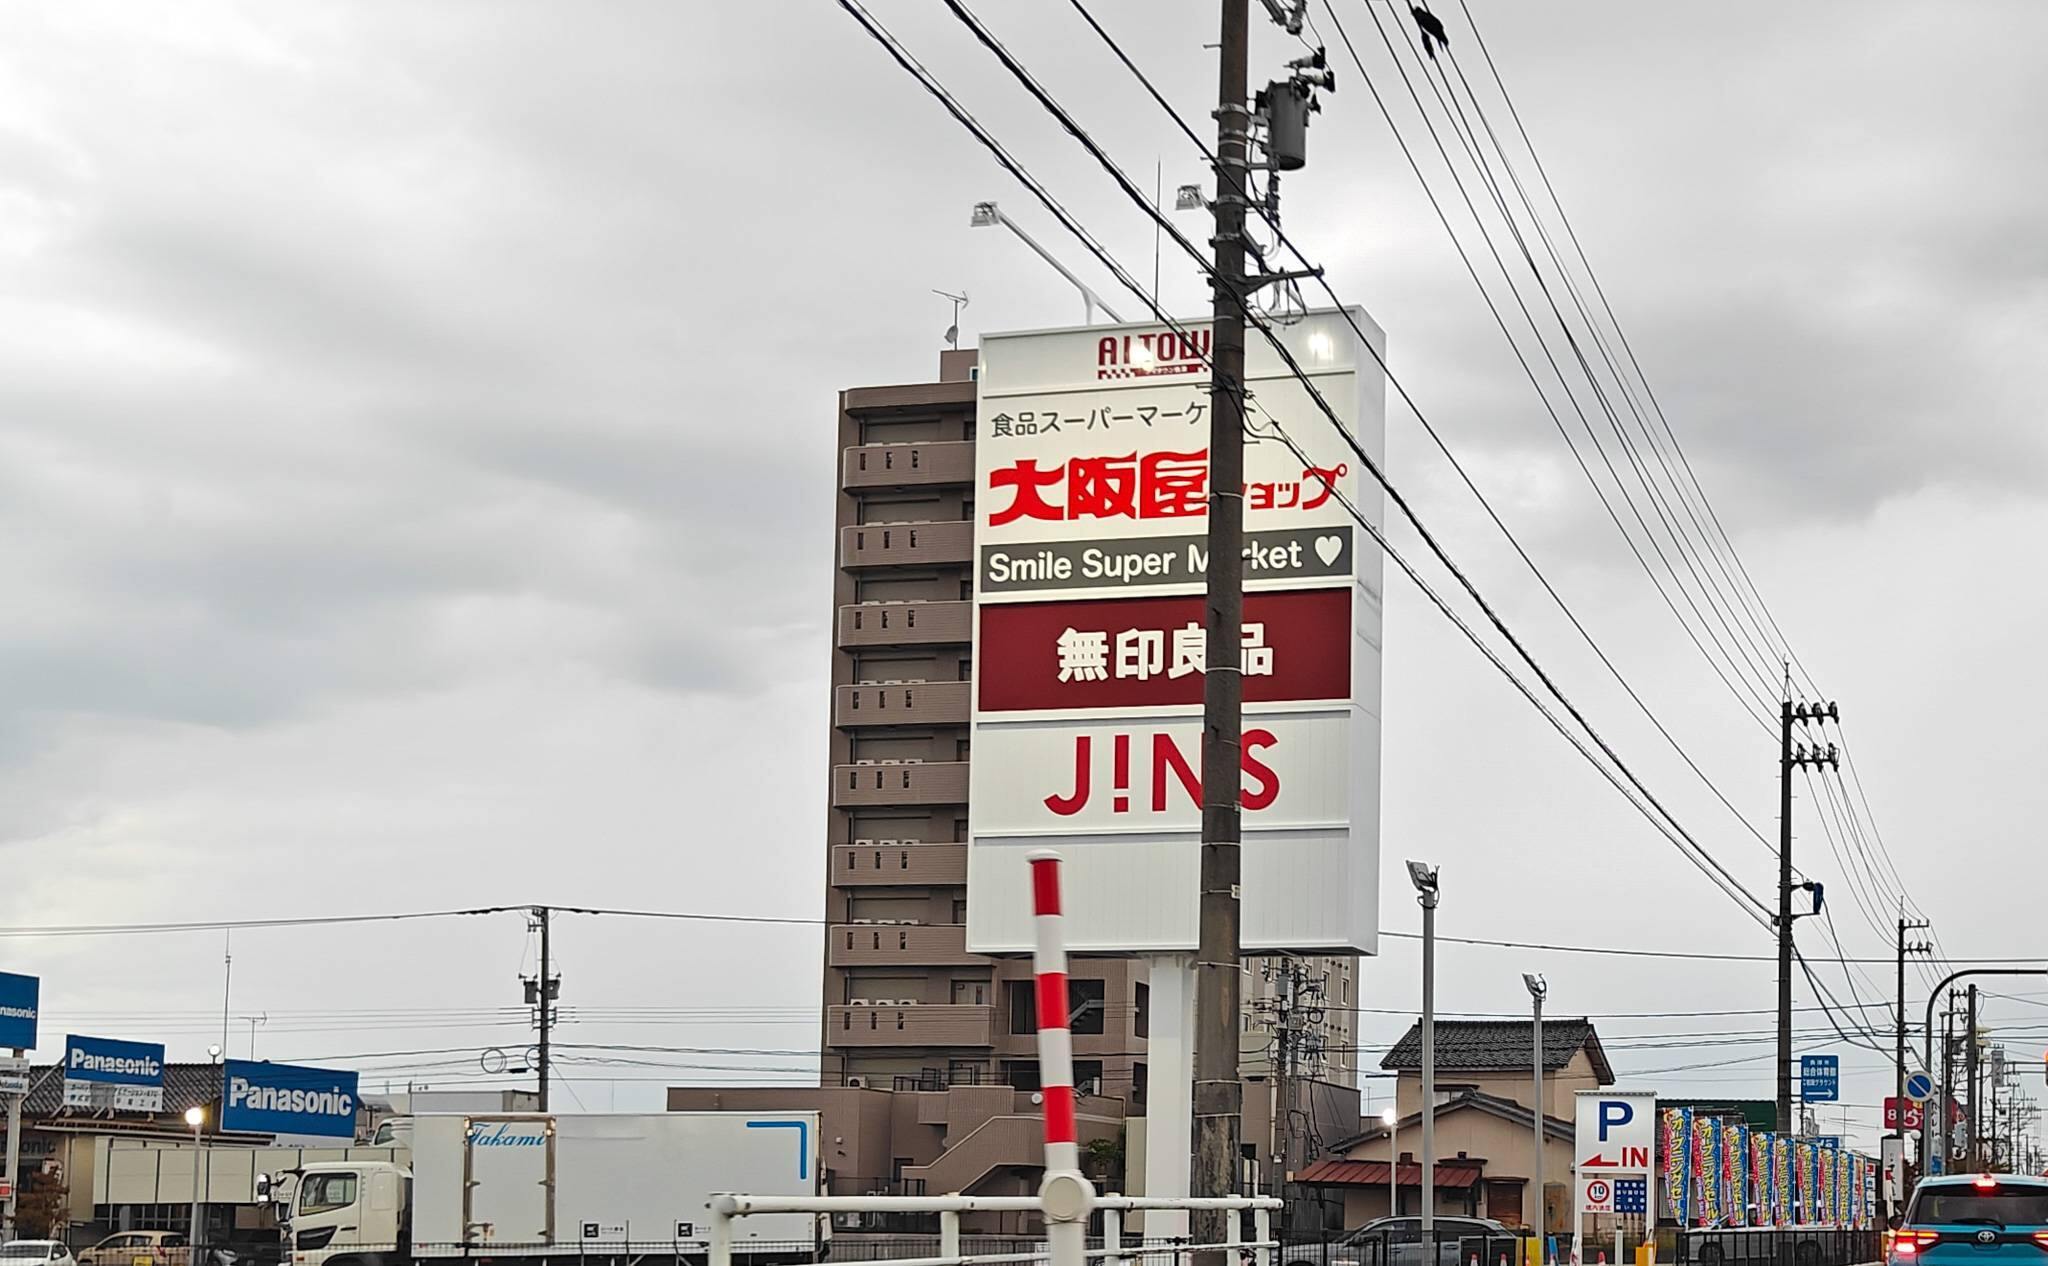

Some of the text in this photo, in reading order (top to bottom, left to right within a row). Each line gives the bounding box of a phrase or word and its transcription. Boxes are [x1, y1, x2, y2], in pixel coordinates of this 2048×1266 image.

[1098, 330, 1211, 366] AITOW
[991, 402, 1257, 439] 食品スーパーマーケ
[988, 447, 1348, 528] 大阪屋ョップ
[988, 540, 1303, 584] Smile Super Mrket
[1055, 621, 1275, 684] 無印良品
[70, 1047, 161, 1077] Panasonic
[229, 1076, 353, 1117] Panasonic
[470, 1122, 546, 1147] Takami
[1599, 1101, 1634, 1142] P
[1622, 1146, 1649, 1168] IN
[1593, 1185, 1606, 1195] 10
